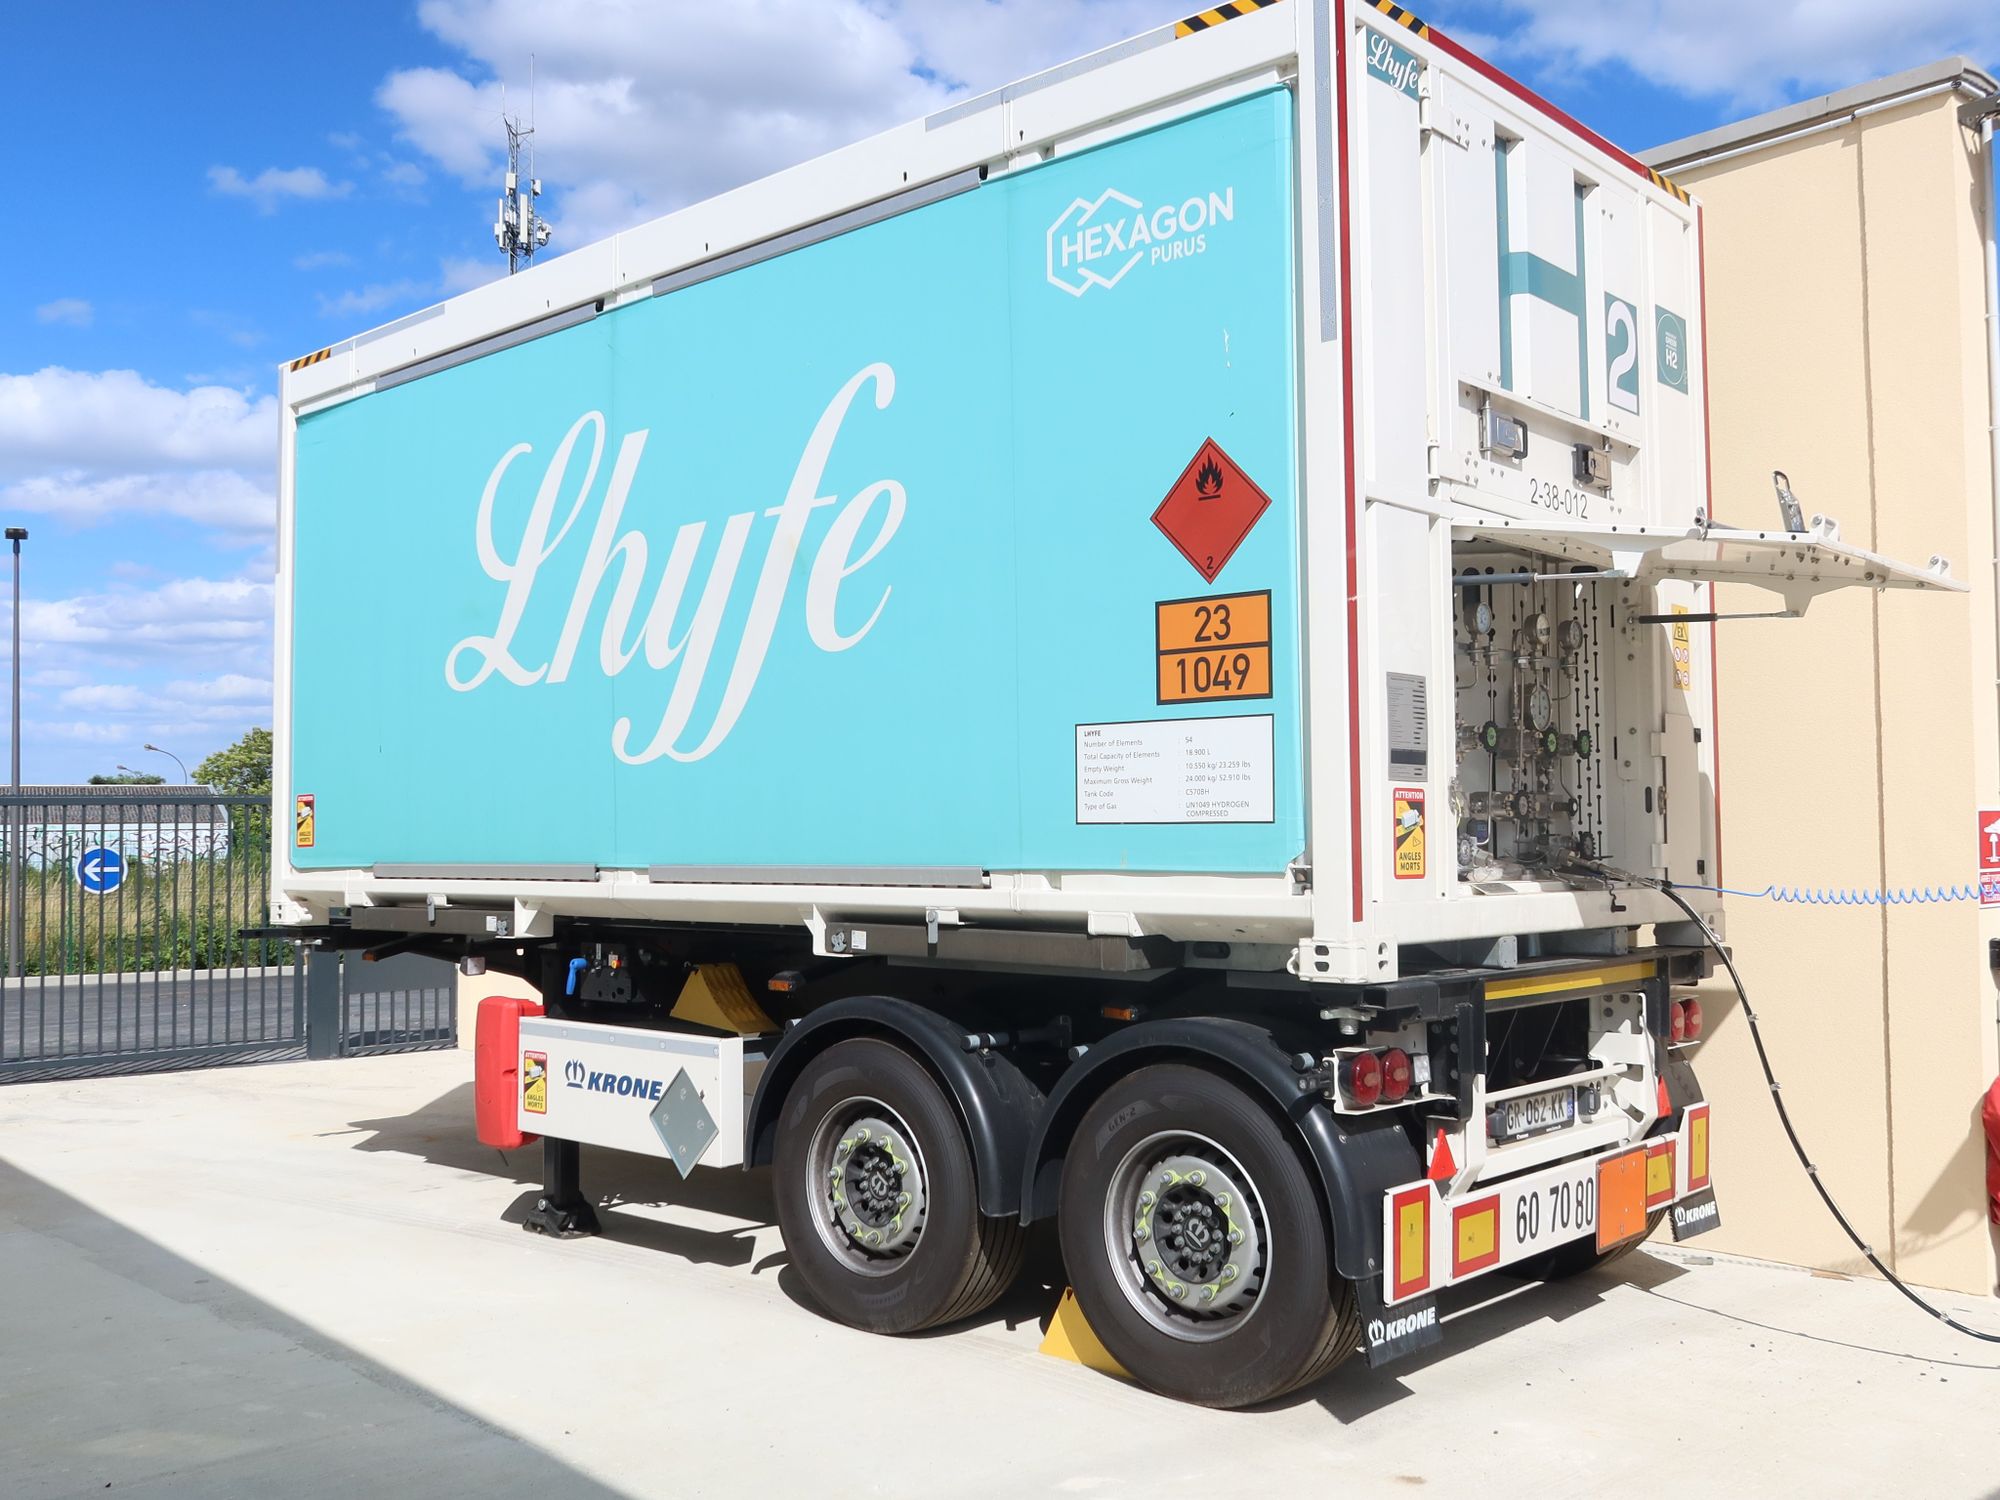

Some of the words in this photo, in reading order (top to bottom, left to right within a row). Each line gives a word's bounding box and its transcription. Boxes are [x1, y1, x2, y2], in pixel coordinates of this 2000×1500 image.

[1368, 34, 1418, 91] Lhyfe
[1061, 186, 1234, 268] HEXAGON
[1151, 233, 1207, 266] PURUS
[1665, 348, 1678, 370] H2
[1529, 478, 1589, 520] 2-38-012
[444, 361, 907, 766] Lhyfe
[1206, 556, 1214, 570] 2
[1194, 603, 1231, 643] 23
[1677, 626, 1684, 638] EX
[1176, 653, 1251, 694] 1049
[1083, 730, 1102, 738] LHYFE
[1116, 739, 1143, 747] Elements
[1100, 752, 1124, 761] Capacity
[1133, 751, 1160, 759] Elements
[1241, 760, 1251, 768] lbs
[1084, 766, 1102, 774] Empty
[1103, 765, 1125, 773] Weight
[1130, 777, 1153, 786] Weight
[1241, 773, 1251, 781] lbs
[1083, 790, 1097, 798] Tank
[1396, 791, 1424, 799] ATTENTION
[1084, 803, 1098, 811] Type
[1211, 800, 1250, 808] HYDROGEN
[1186, 809, 1229, 817] COMPRESSED
[1399, 852, 1422, 861] ANGLES
[1400, 861, 1421, 871] MORTS
[587, 1071, 663, 1101] KRONE
[526, 1094, 544, 1103] ANGLES
[527, 1101, 543, 1110] MORTS
[1506, 1092, 1565, 1130] GR-062-KK
[1516, 1191, 1540, 1244] 60
[1549, 1181, 1571, 1233] 70
[1575, 1177, 1594, 1230] 80
[1686, 1200, 1716, 1224] KRONE
[1385, 1306, 1436, 1342] KRONE
